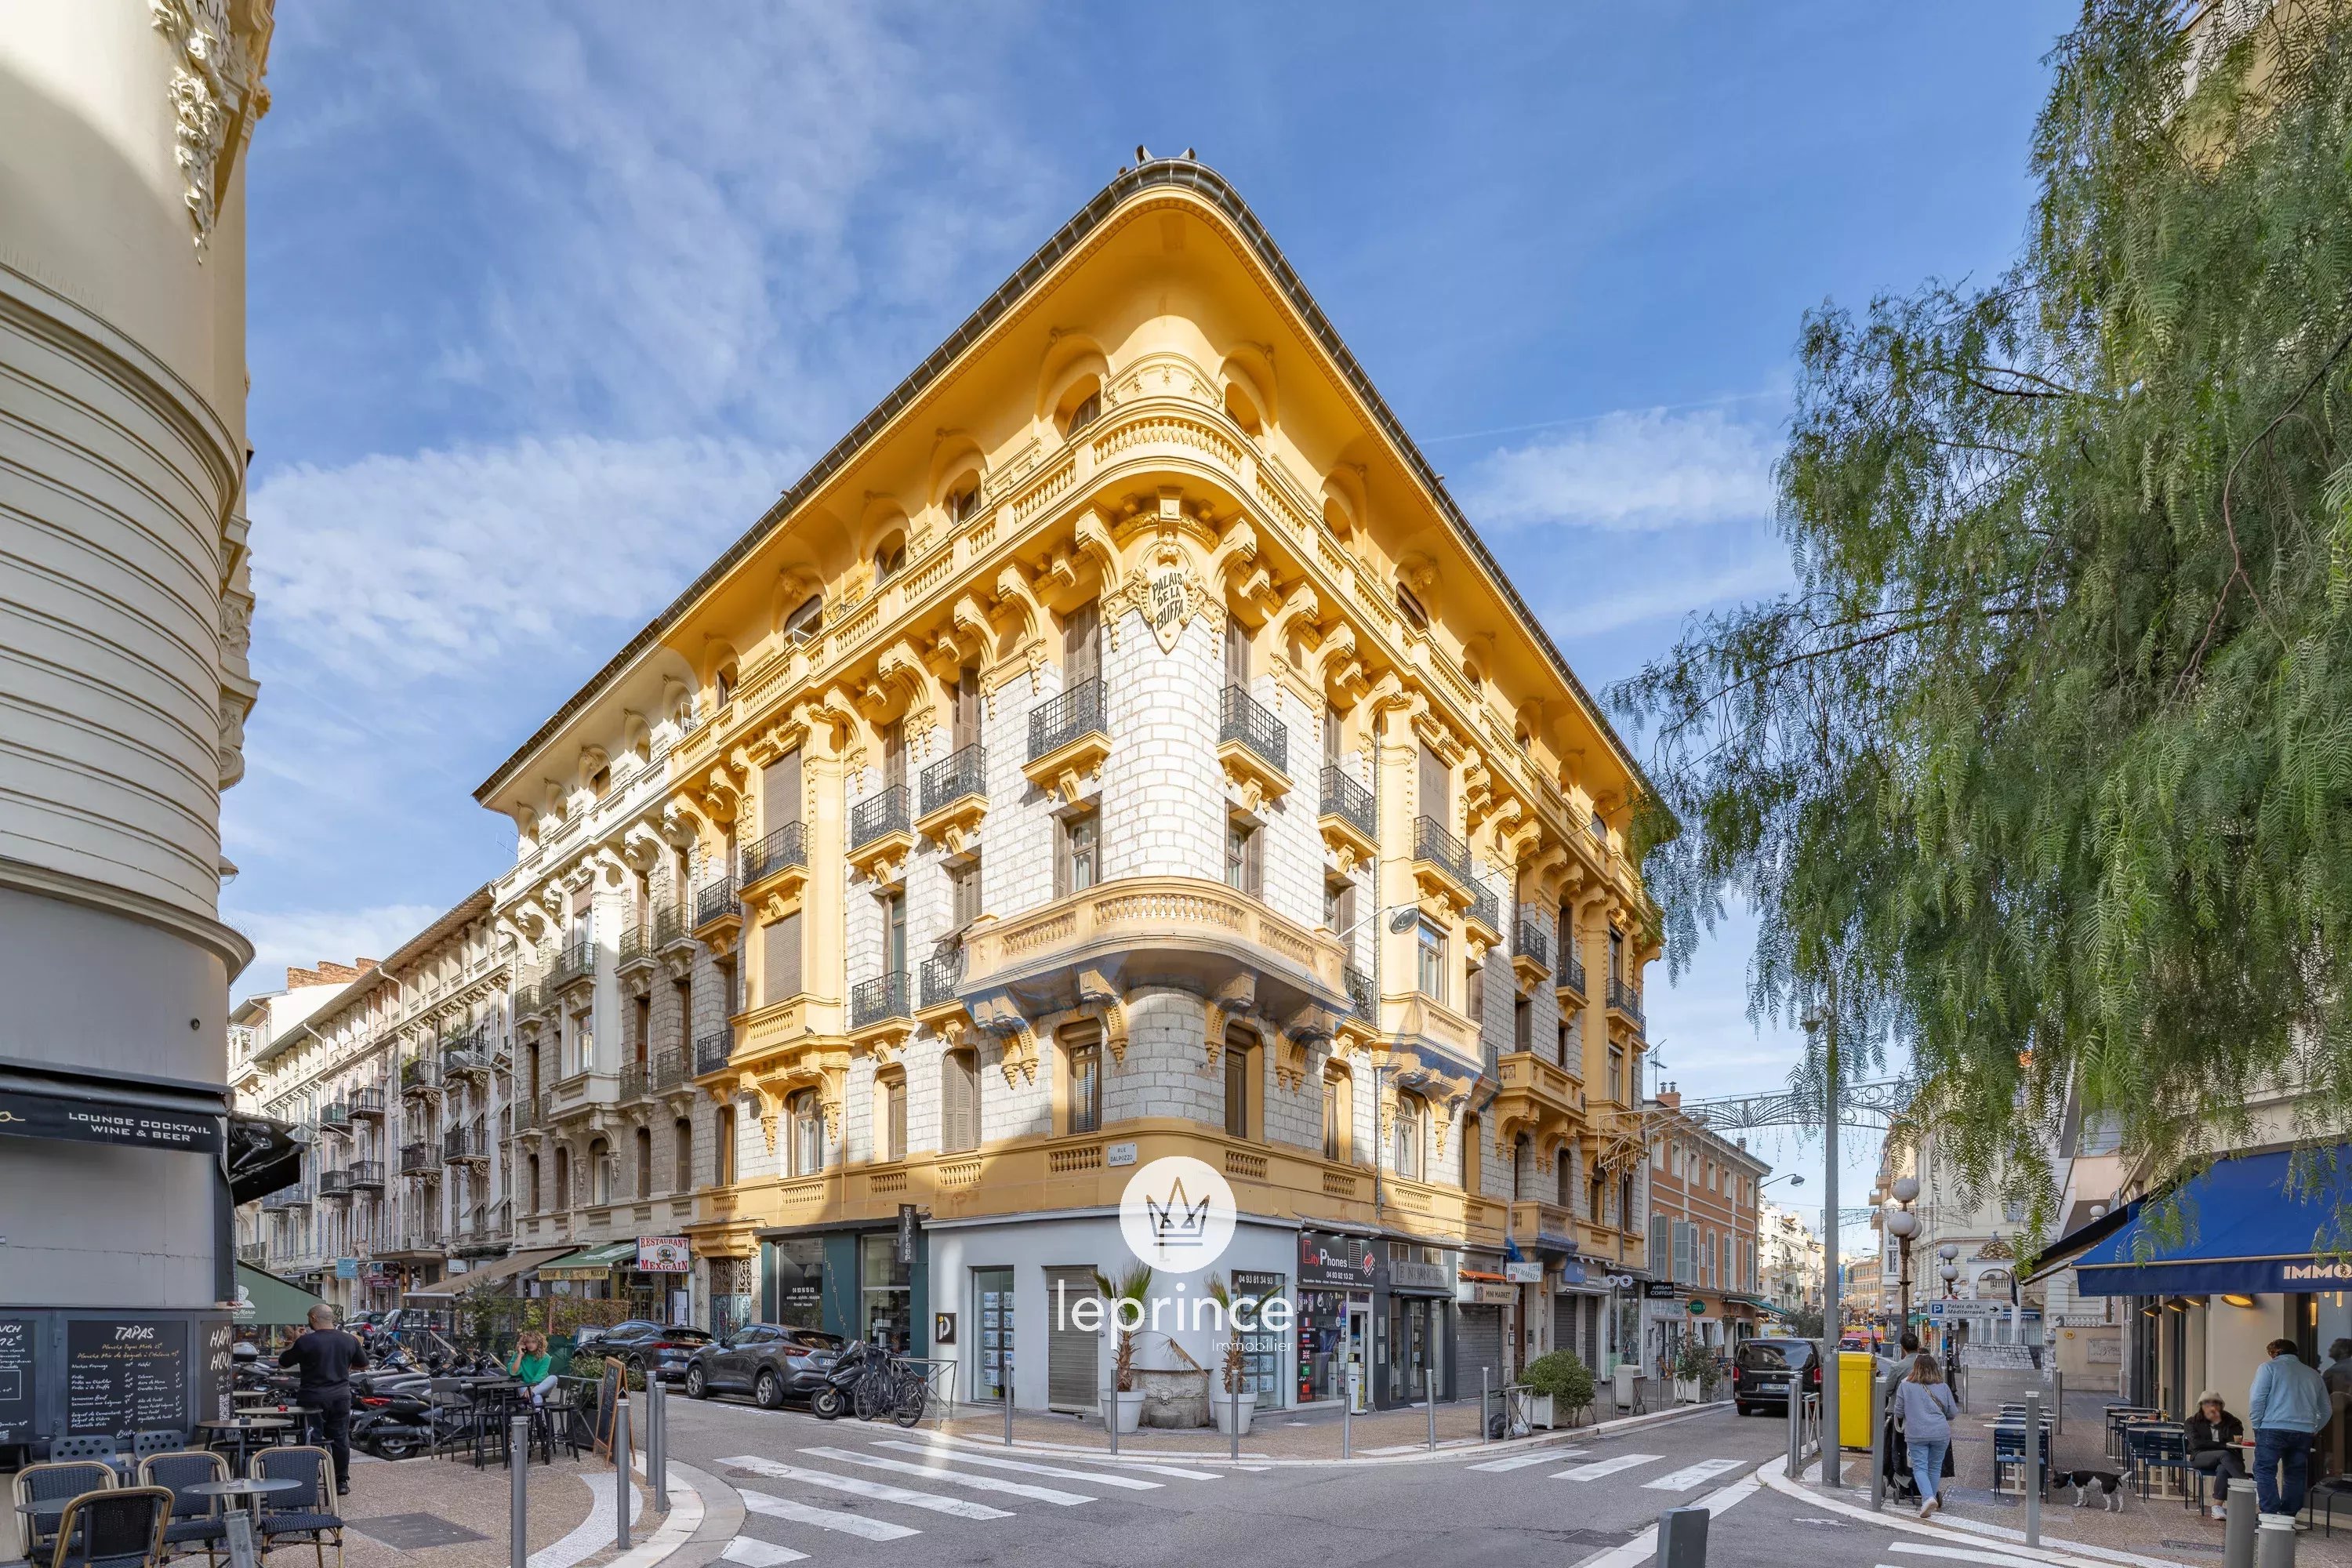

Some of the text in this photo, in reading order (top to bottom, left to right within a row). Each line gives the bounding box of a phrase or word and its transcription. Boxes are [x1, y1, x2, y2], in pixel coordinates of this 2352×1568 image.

[1152, 572, 1182, 602] PALAIS
[1157, 586, 1181, 608] DE LA
[1156, 599, 1183, 631] BUFFA
[68, 1112, 211, 1134] LOUNGE COCKTAIL
[91, 1125, 131, 1136] WINE
[153, 1131, 191, 1142] BEER
[640, 1237, 688, 1250] RESTAURANT
[1239, 1275, 1245, 1283] 04
[1246, 1275, 1252, 1283] 93
[1260, 1276, 1266, 1284] 34
[1407, 1266, 1444, 1281] NUANCIER
[1509, 1265, 1539, 1281] MINI MARKET
[1486, 1290, 1511, 1299] MINI MARKET
[1933, 1305, 1941, 1313] P
[115, 1325, 155, 1341] TAPAS
